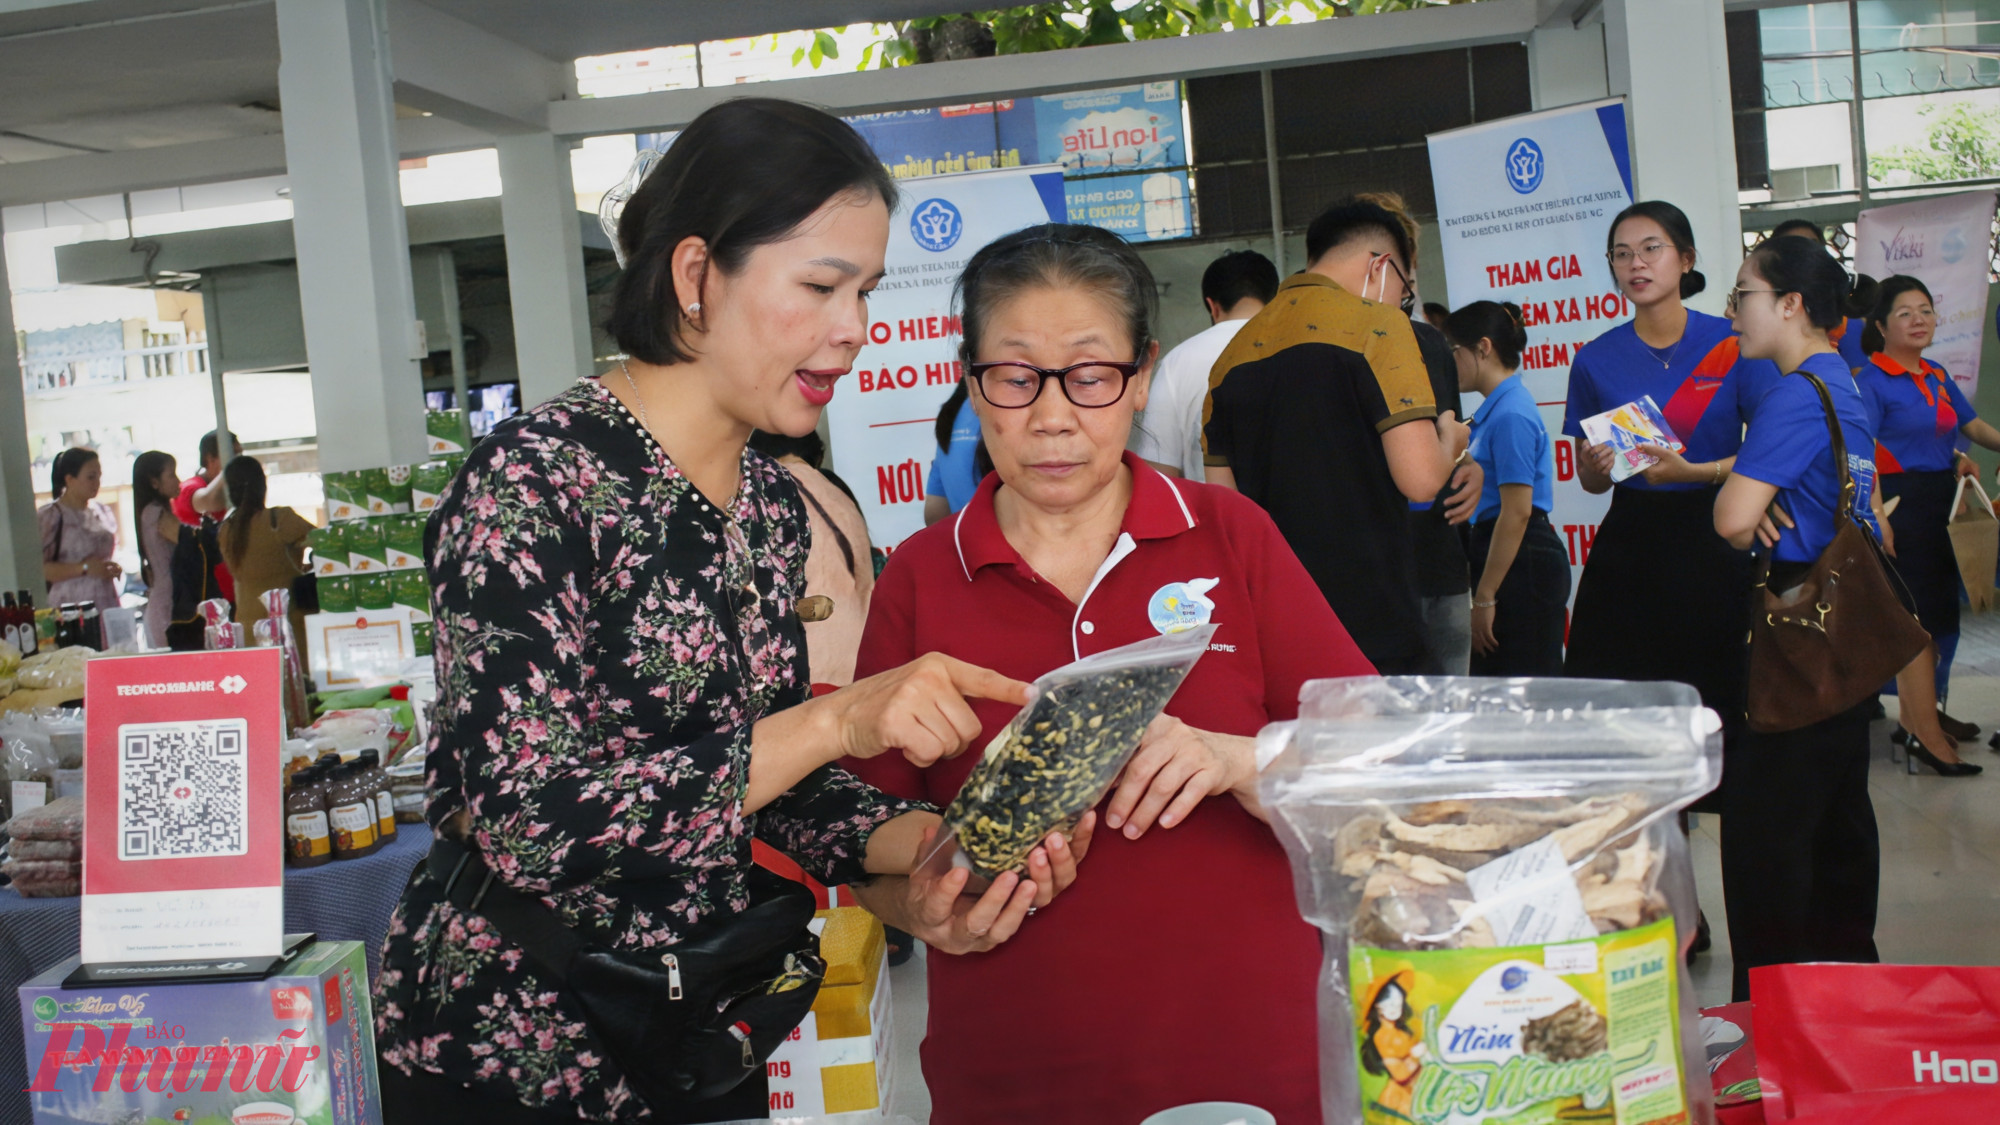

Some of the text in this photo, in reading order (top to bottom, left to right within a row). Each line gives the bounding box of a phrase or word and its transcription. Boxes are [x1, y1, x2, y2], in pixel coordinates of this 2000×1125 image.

[1486, 253, 1583, 288] THAM GIA
[767, 1060, 791, 1079] ng
[1912, 1050, 1999, 1084] Hao
